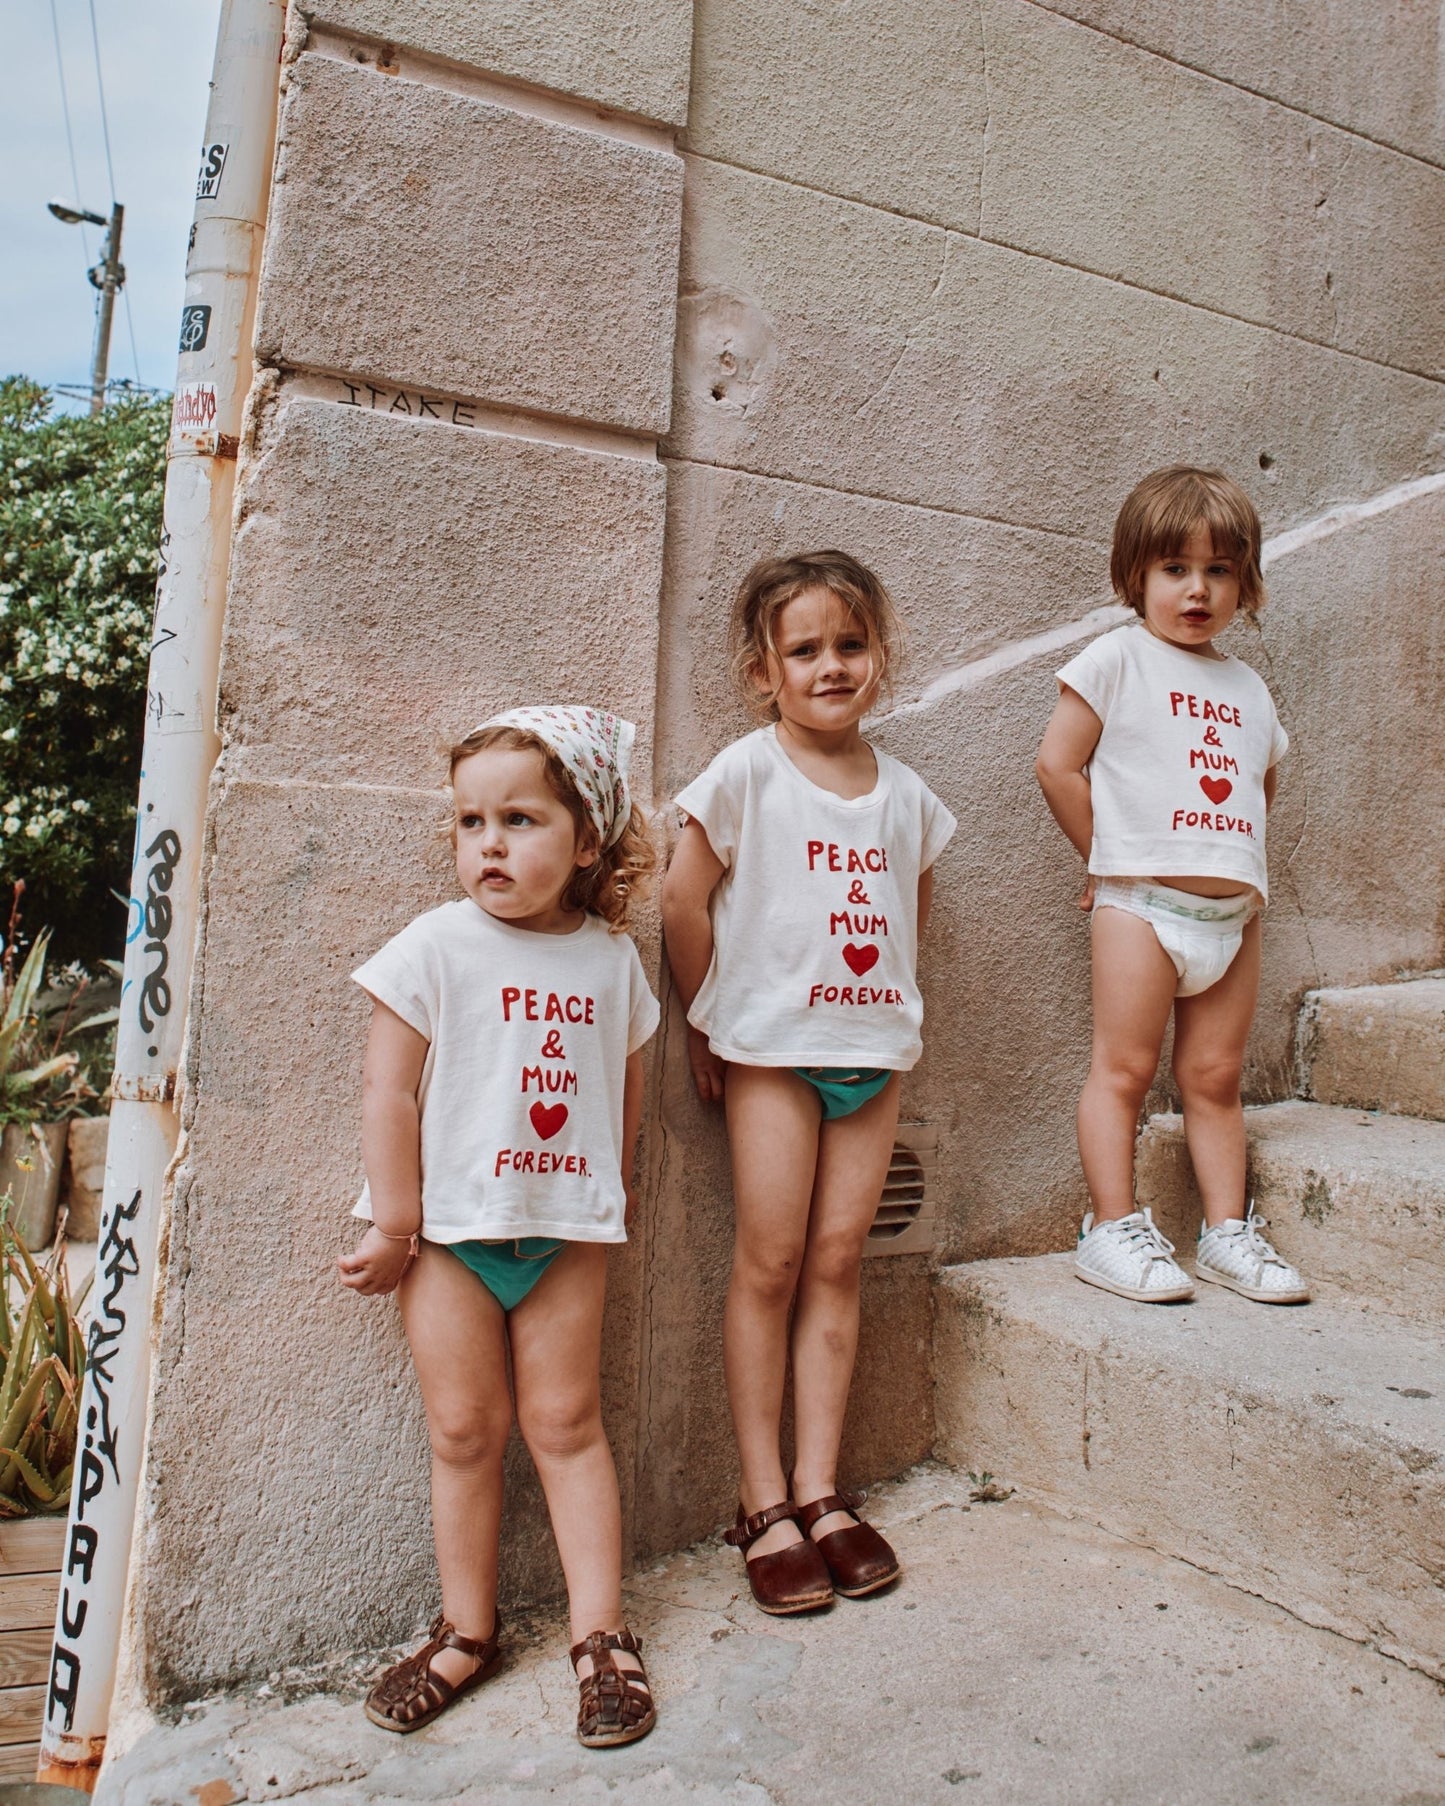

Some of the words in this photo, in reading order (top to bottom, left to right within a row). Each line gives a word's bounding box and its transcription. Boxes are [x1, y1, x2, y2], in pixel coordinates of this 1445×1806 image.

[1169, 691, 1242, 728] PEACE
[1203, 725, 1223, 748] &
[1189, 749, 1239, 776] MUM
[1172, 809, 1257, 841] FOREVER.
[847, 879, 871, 905] &
[830, 910, 889, 936] MUM
[501, 987, 595, 1025] PEACE
[541, 1029, 566, 1060] &
[521, 1065, 578, 1096] MUM
[494, 1148, 593, 1178] FOREVER.
